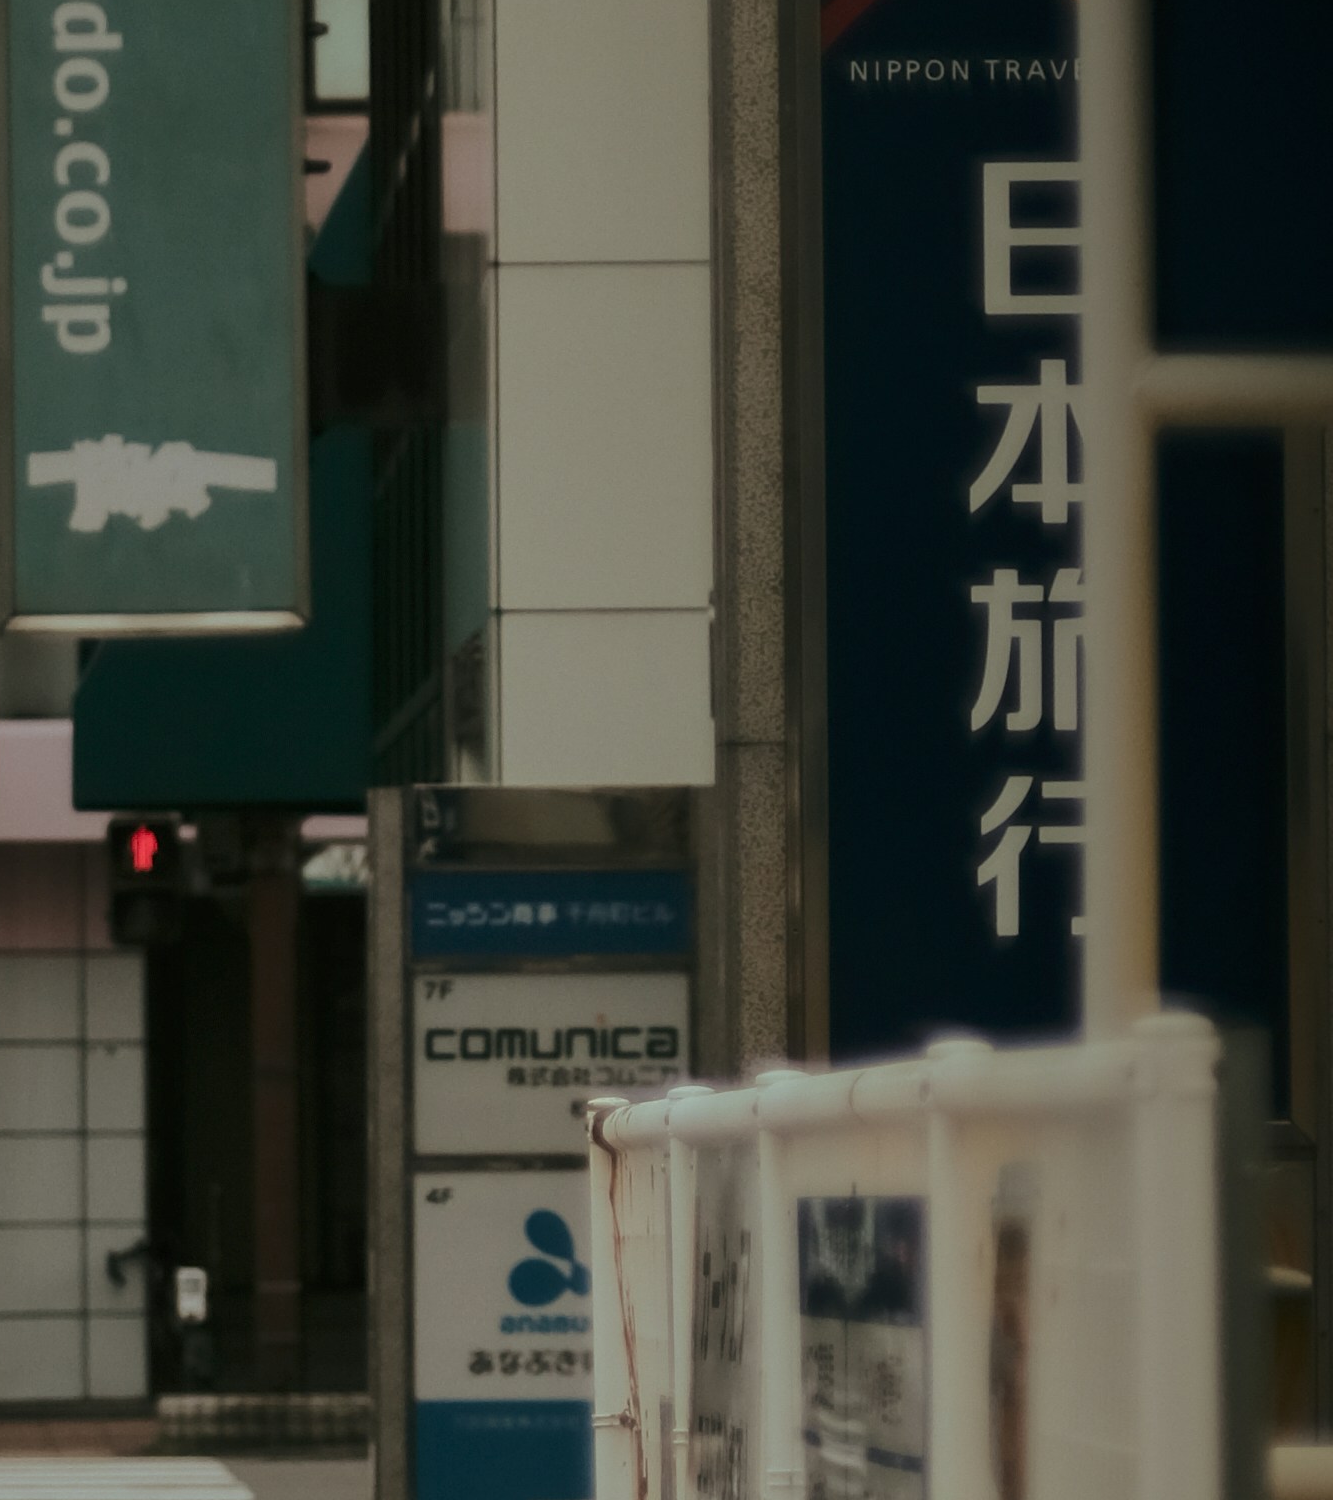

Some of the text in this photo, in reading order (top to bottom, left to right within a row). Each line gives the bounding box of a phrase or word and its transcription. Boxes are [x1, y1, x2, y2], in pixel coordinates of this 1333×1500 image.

[850, 58, 970, 82] NIPPON
[969, 161, 1084, 937] 日本旅行
[424, 981, 454, 1000] 7F
[425, 1015, 679, 1060] comunica
[426, 1187, 453, 1204] 4F
